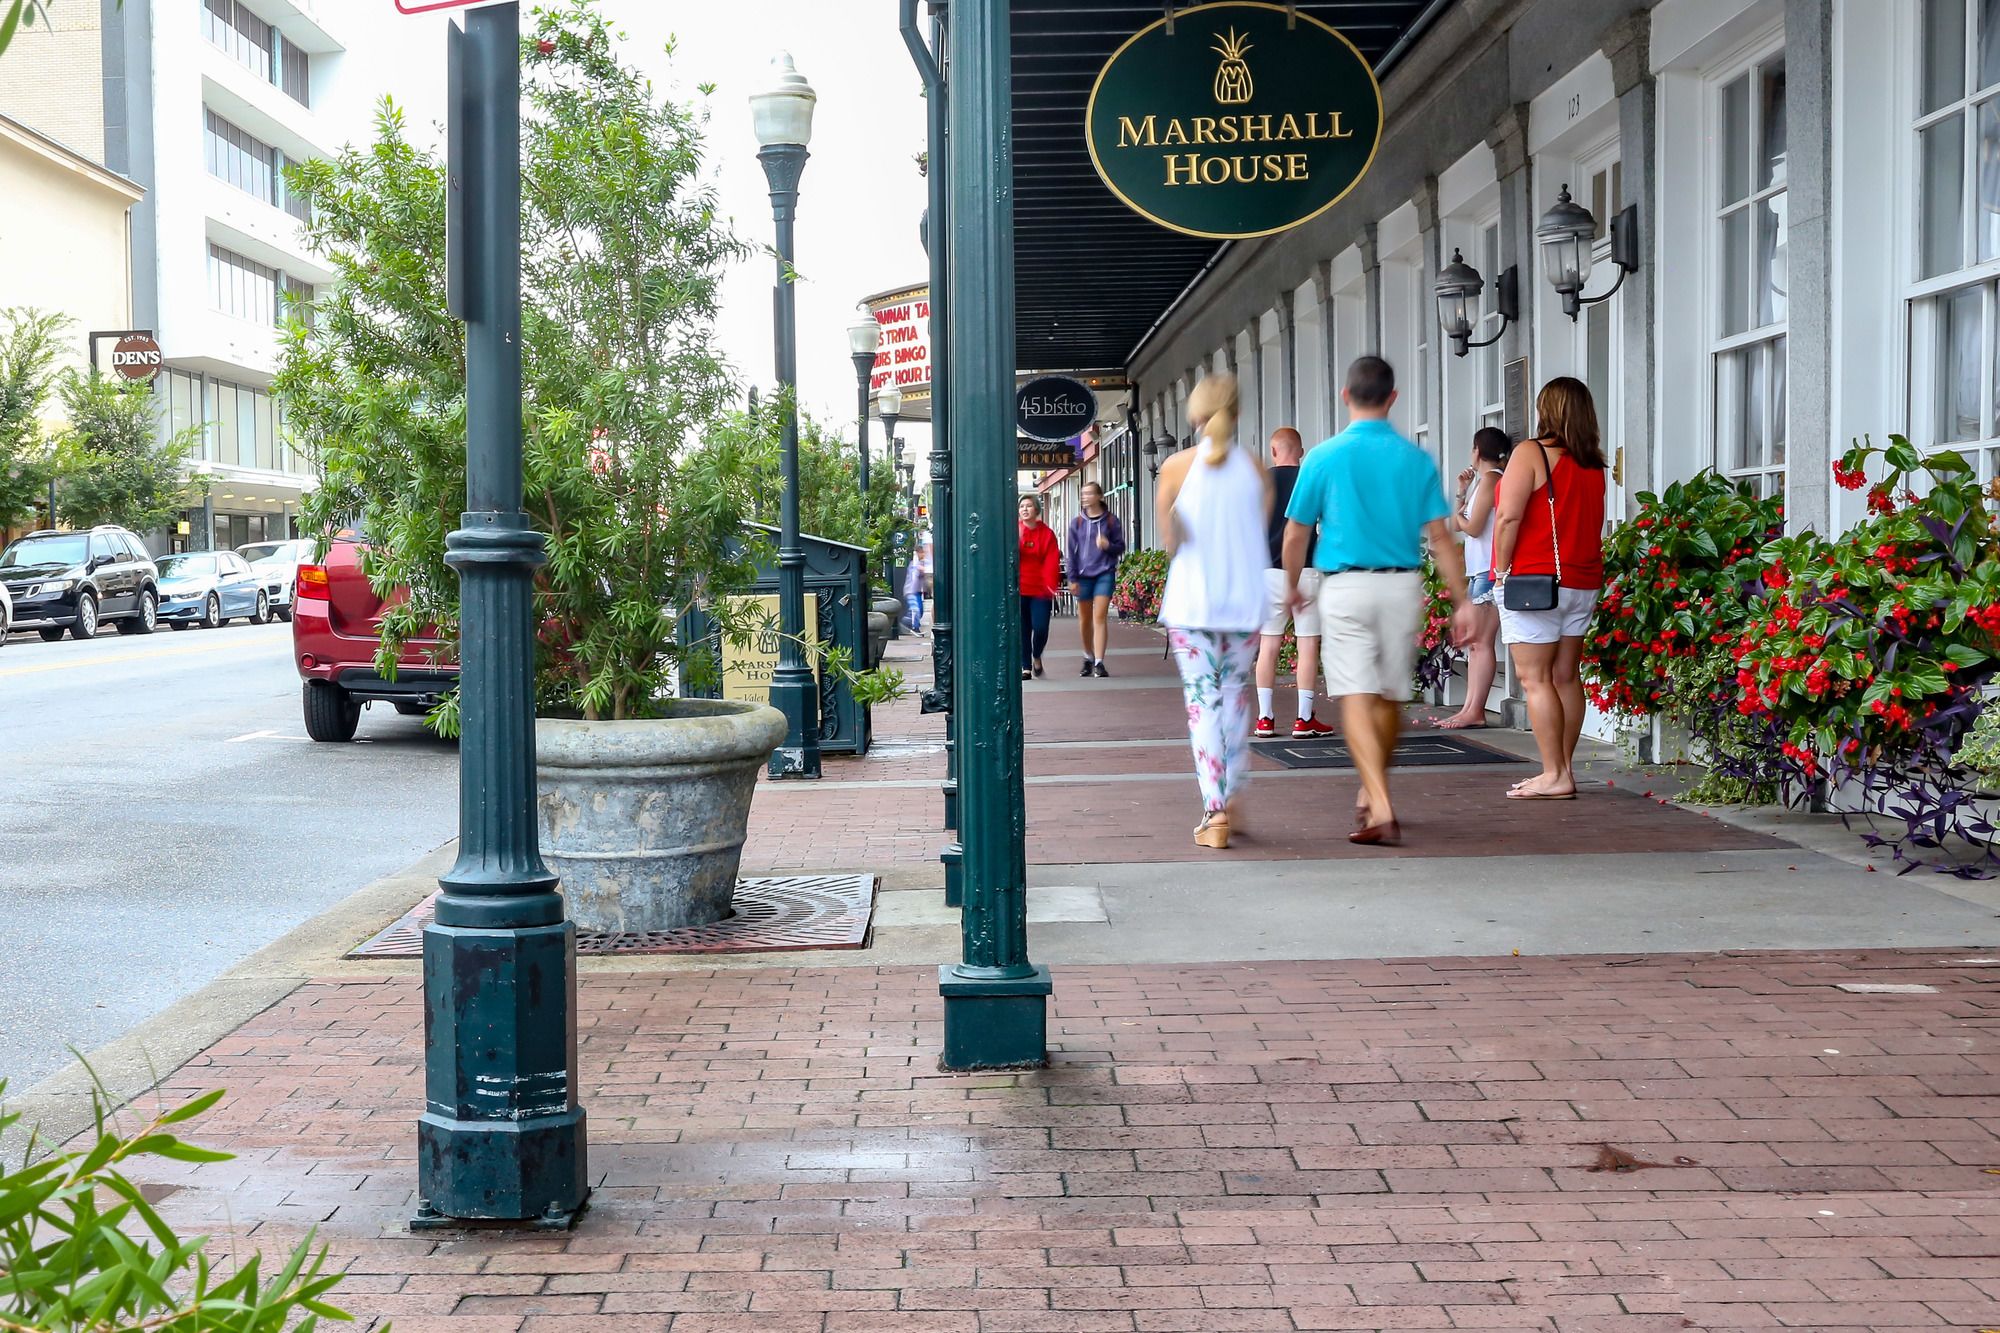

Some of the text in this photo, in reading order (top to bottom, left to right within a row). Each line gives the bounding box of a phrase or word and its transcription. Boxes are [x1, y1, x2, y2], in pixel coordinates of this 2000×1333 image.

[1568, 93, 1580, 120] 123
[1116, 111, 1353, 148] MARSHALL
[1162, 152, 1309, 186] HOUSE
[886, 325, 918, 345] TRIVIA
[114, 351, 160, 364] DEN'S
[895, 345, 926, 364] BINGO
[895, 367, 922, 386] HOUR
[1020, 393, 1086, 419] 45 bistro
[1019, 453, 1072, 464] HOUSE
